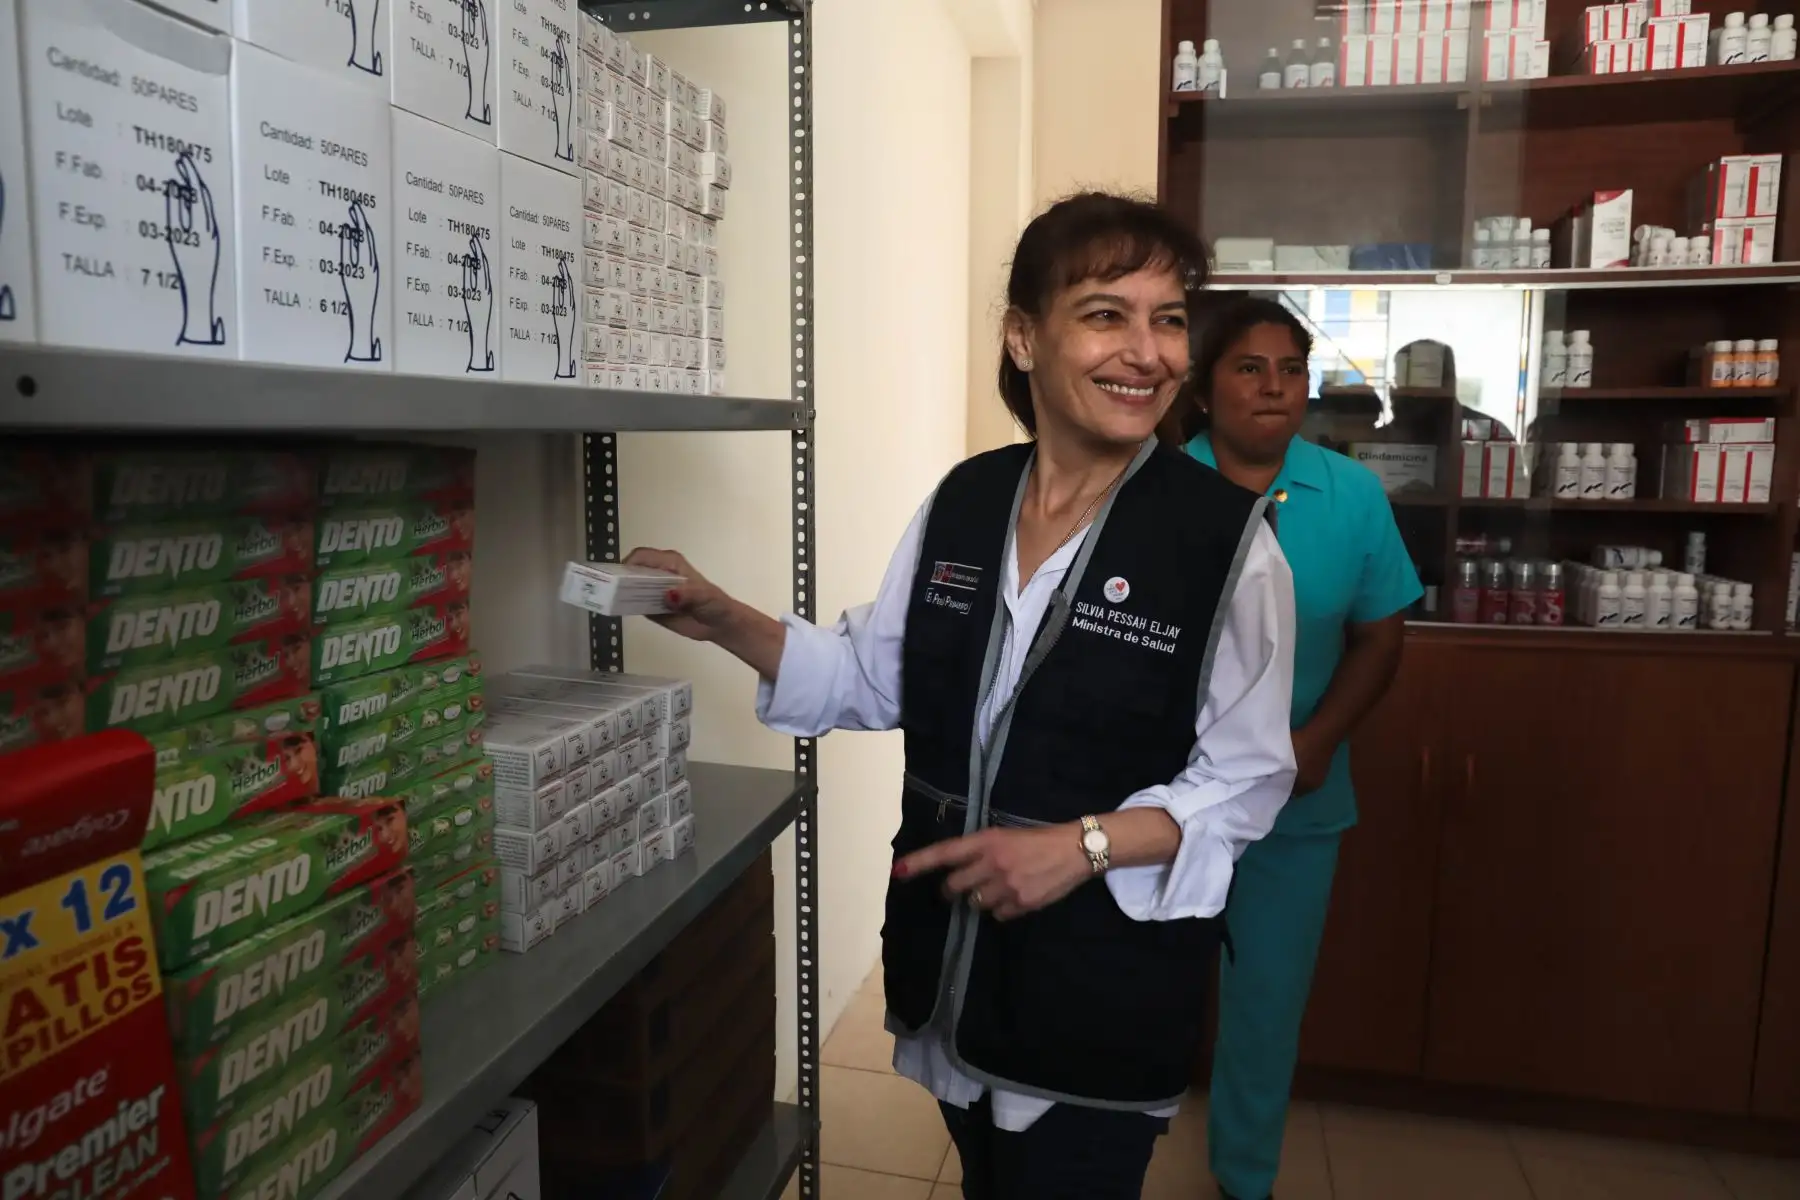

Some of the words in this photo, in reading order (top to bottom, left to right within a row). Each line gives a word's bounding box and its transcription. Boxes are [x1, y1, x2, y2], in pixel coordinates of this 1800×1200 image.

[410, 37, 437, 61] TALLA
[448, 58, 453, 70] 7
[55, 101, 93, 128] Lote
[511, 90, 532, 109] TALLA
[541, 105, 546, 116] 7
[319, 139, 369, 168] 50PARES
[264, 163, 290, 185] Lote
[448, 183, 485, 206] 50PARES
[407, 207, 428, 224] Lote
[511, 236, 526, 251] Lote
[62, 252, 116, 278] TALLA
[140, 268, 151, 287] 7
[156, 270, 180, 290] 1/2
[263, 288, 301, 308] TALLA
[319, 298, 327, 313] 6
[331, 300, 349, 316] 1/2
[407, 311, 435, 328] TALLA
[447, 318, 453, 331] 7
[456, 319, 469, 334] 1/2
[509, 327, 531, 341] TALLA
[541, 332, 546, 344] 7
[1357, 451, 1429, 463] Clindamicina
[319, 516, 404, 556] DENTO
[107, 533, 222, 582] DENTO
[316, 571, 401, 613] DENTO
[105, 599, 221, 656] DENTO
[1075, 601, 1105, 620] SILVIA
[1107, 609, 1148, 631] PESSAH
[318, 624, 402, 670] DENTO
[1072, 616, 1121, 640] Ministra
[1123, 631, 1139, 644] de
[1141, 635, 1176, 654] Salud
[107, 664, 221, 725] DENTO
[338, 693, 387, 725] DENTO
[336, 732, 387, 768] DENTO
[146, 773, 217, 836] NTO
[60, 862, 137, 934] 12
[191, 852, 311, 941] DENTO
[324, 824, 372, 868] Herbal
[213, 929, 325, 1026] DENTO
[218, 997, 328, 1101] DENTO
[222, 1063, 333, 1177] DENTO
[1, 1083, 166, 1200] Premier
